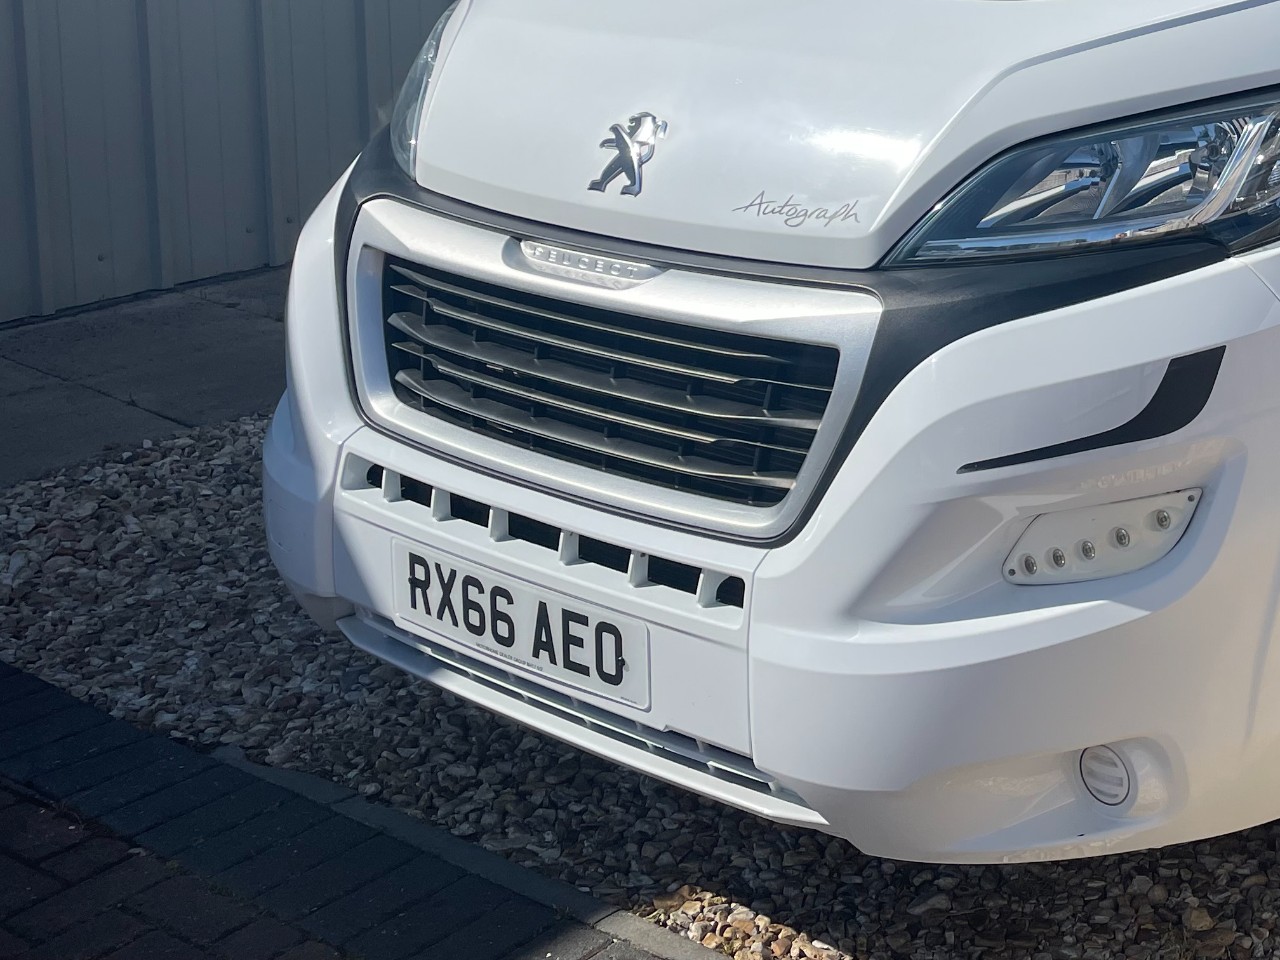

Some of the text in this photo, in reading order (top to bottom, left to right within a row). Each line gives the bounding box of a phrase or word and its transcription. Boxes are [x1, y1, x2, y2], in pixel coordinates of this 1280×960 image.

[732, 190, 861, 228] Autograph
[533, 246, 638, 278] PEUGEOT
[408, 551, 625, 686] RX66 AEO
